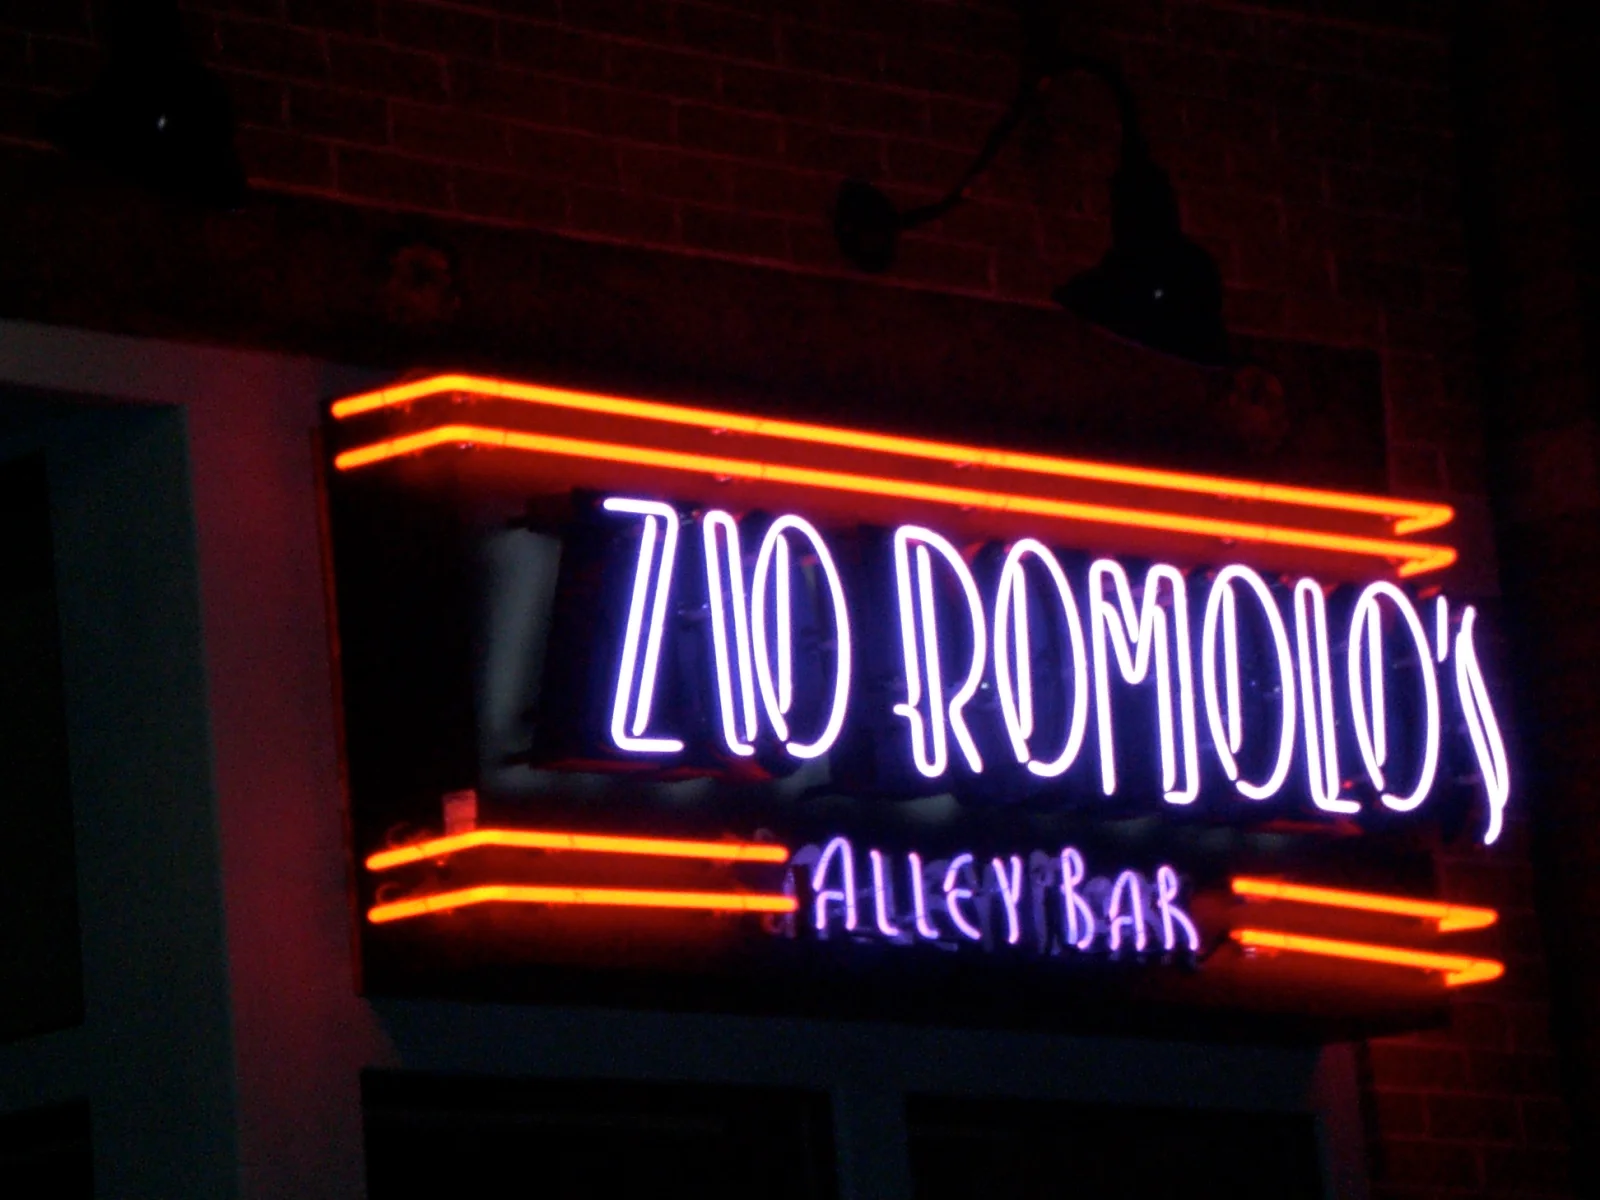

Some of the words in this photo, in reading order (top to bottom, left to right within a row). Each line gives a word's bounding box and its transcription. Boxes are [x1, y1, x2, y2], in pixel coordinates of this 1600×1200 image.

[602, 497, 852, 760] ZIO
[893, 525, 1511, 846] ROMOLO'S
[812, 837, 1021, 944] ALLEY
[1060, 847, 1200, 951] BAR
